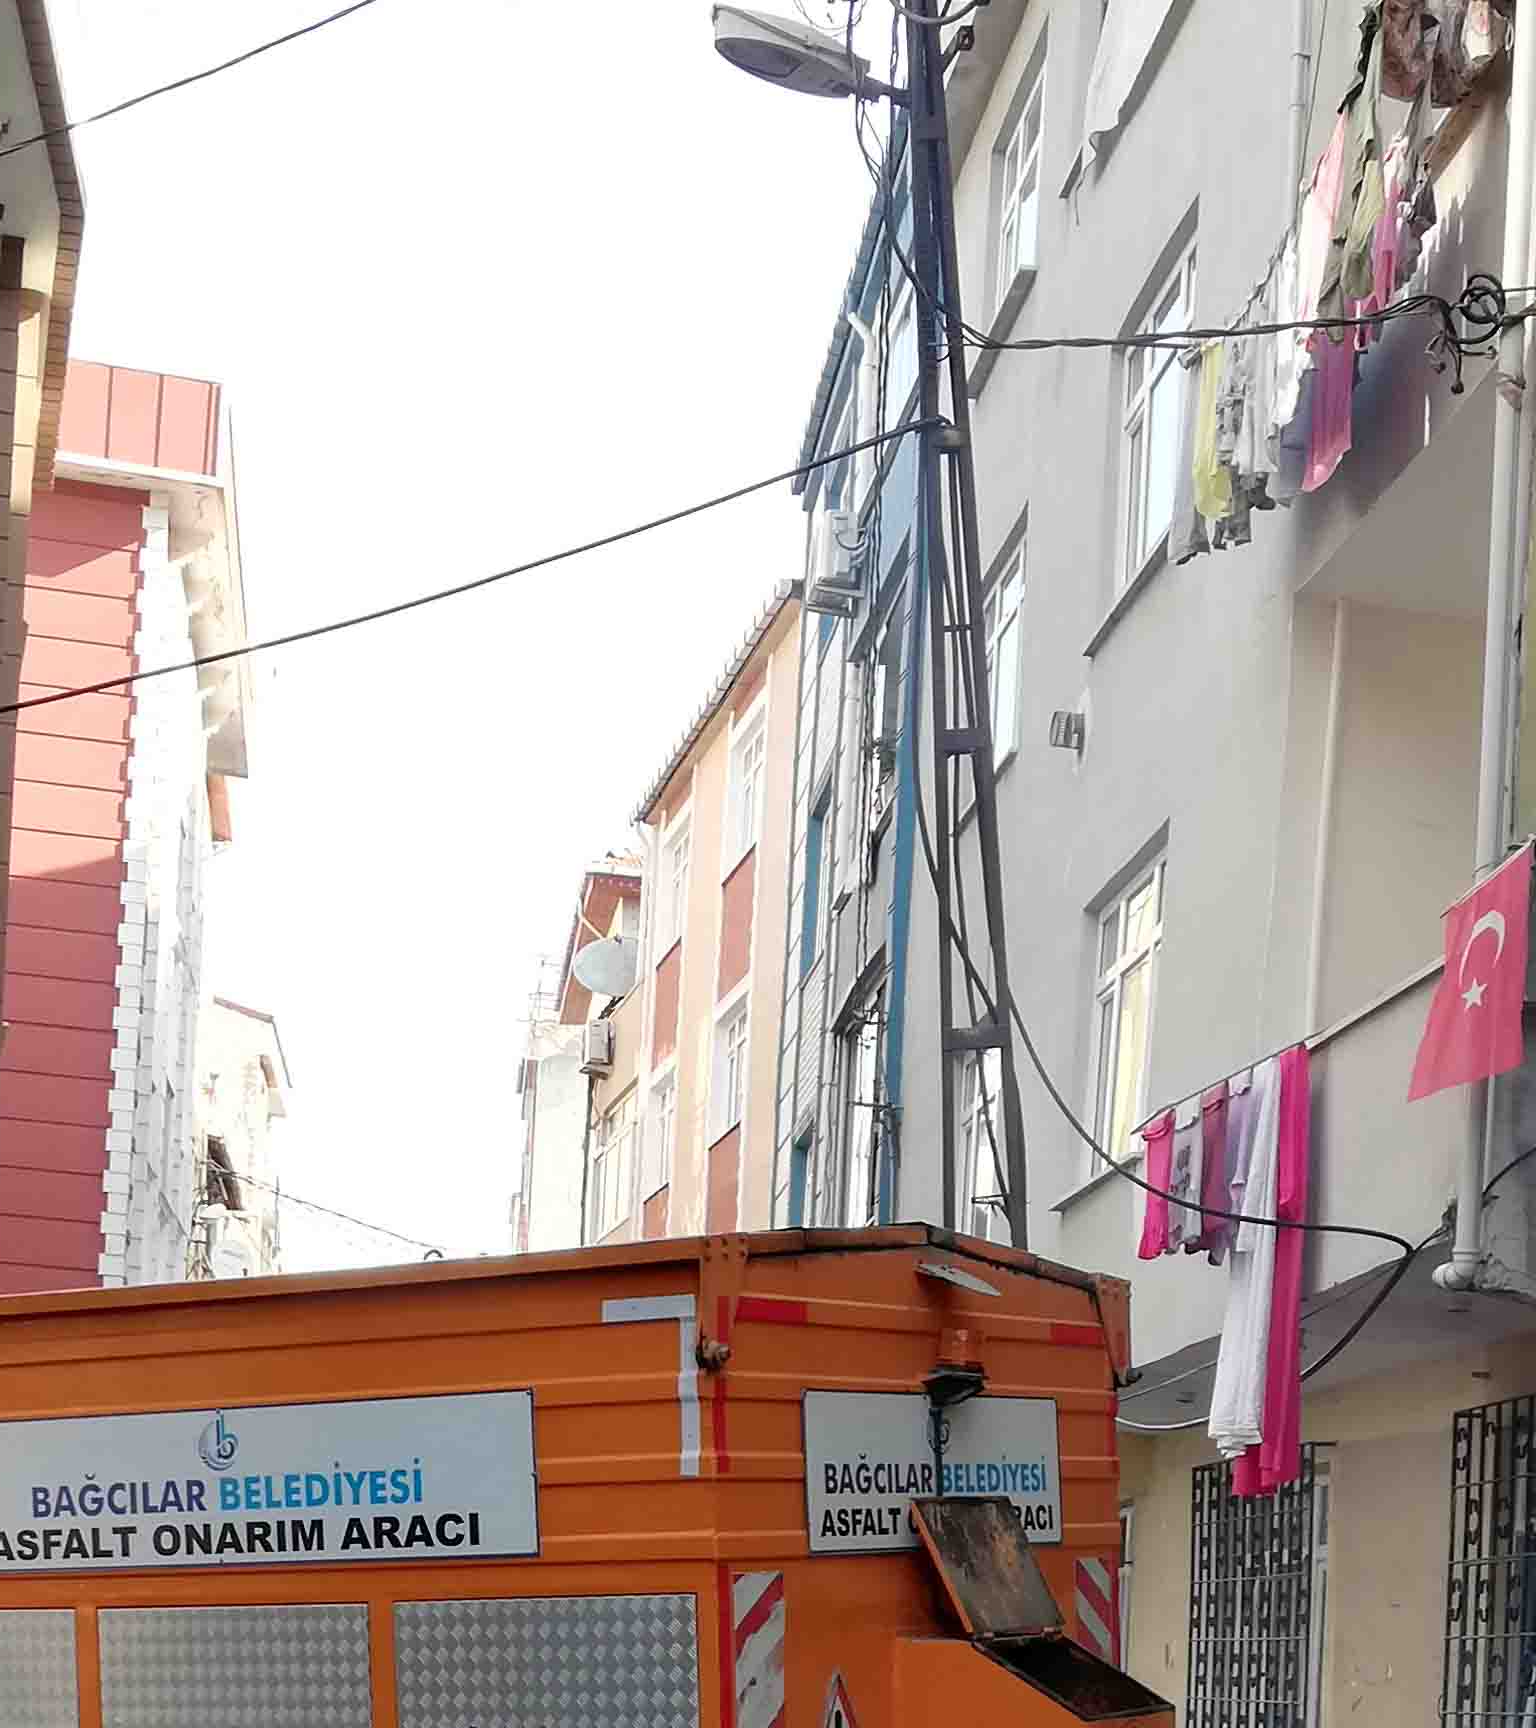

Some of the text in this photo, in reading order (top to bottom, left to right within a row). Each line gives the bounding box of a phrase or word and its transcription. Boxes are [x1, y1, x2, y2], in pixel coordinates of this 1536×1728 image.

[32, 1457, 423, 1518] BAĞCILAR BELEDİYESİ
[824, 1453, 1047, 1494] BAĞCILAR BELEDİYESİ
[153, 1519, 325, 1556] ONARIM
[341, 1512, 480, 1551] ARACI
[821, 1507, 901, 1537] ASFALT
